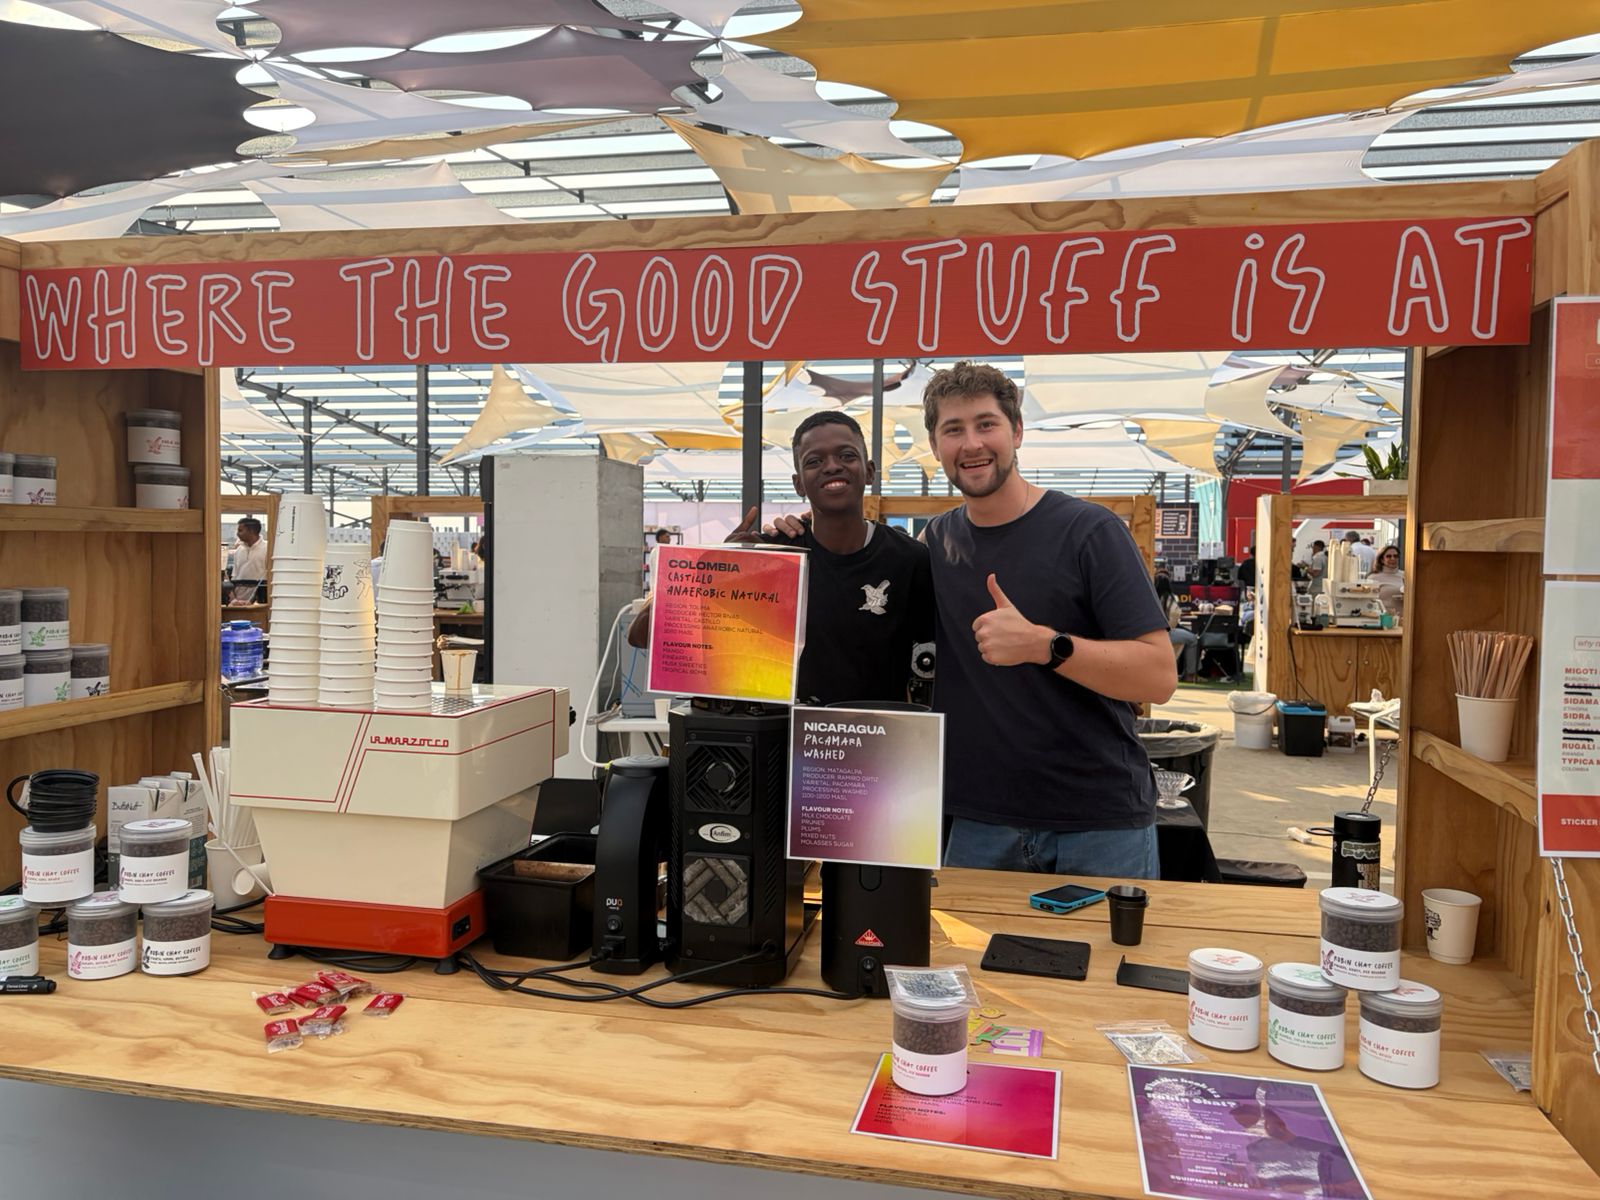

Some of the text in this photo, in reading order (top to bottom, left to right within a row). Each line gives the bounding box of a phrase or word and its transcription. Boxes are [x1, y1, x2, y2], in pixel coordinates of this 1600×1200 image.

[26, 267, 294, 366] WHERE
[340, 256, 512, 359] THE
[562, 253, 803, 364] GOOD
[850, 235, 1176, 352] STUFF
[1387, 218, 1532, 339] AT
[668, 560, 740, 573] COLOMBIA
[731, 590, 780, 603] NATURAL
[804, 722, 886, 735] NICARAGUA
[385, 736, 449, 747] MARZOCCO
[804, 734, 862, 747] PACAMARA
[804, 749, 845, 760] WASHED
[1561, 818, 1598, 826] STICKER
[606, 898, 623, 906] DUO
[1392, 1048, 1415, 1057] COFFEE
[916, 1064, 938, 1072] COFFEE
